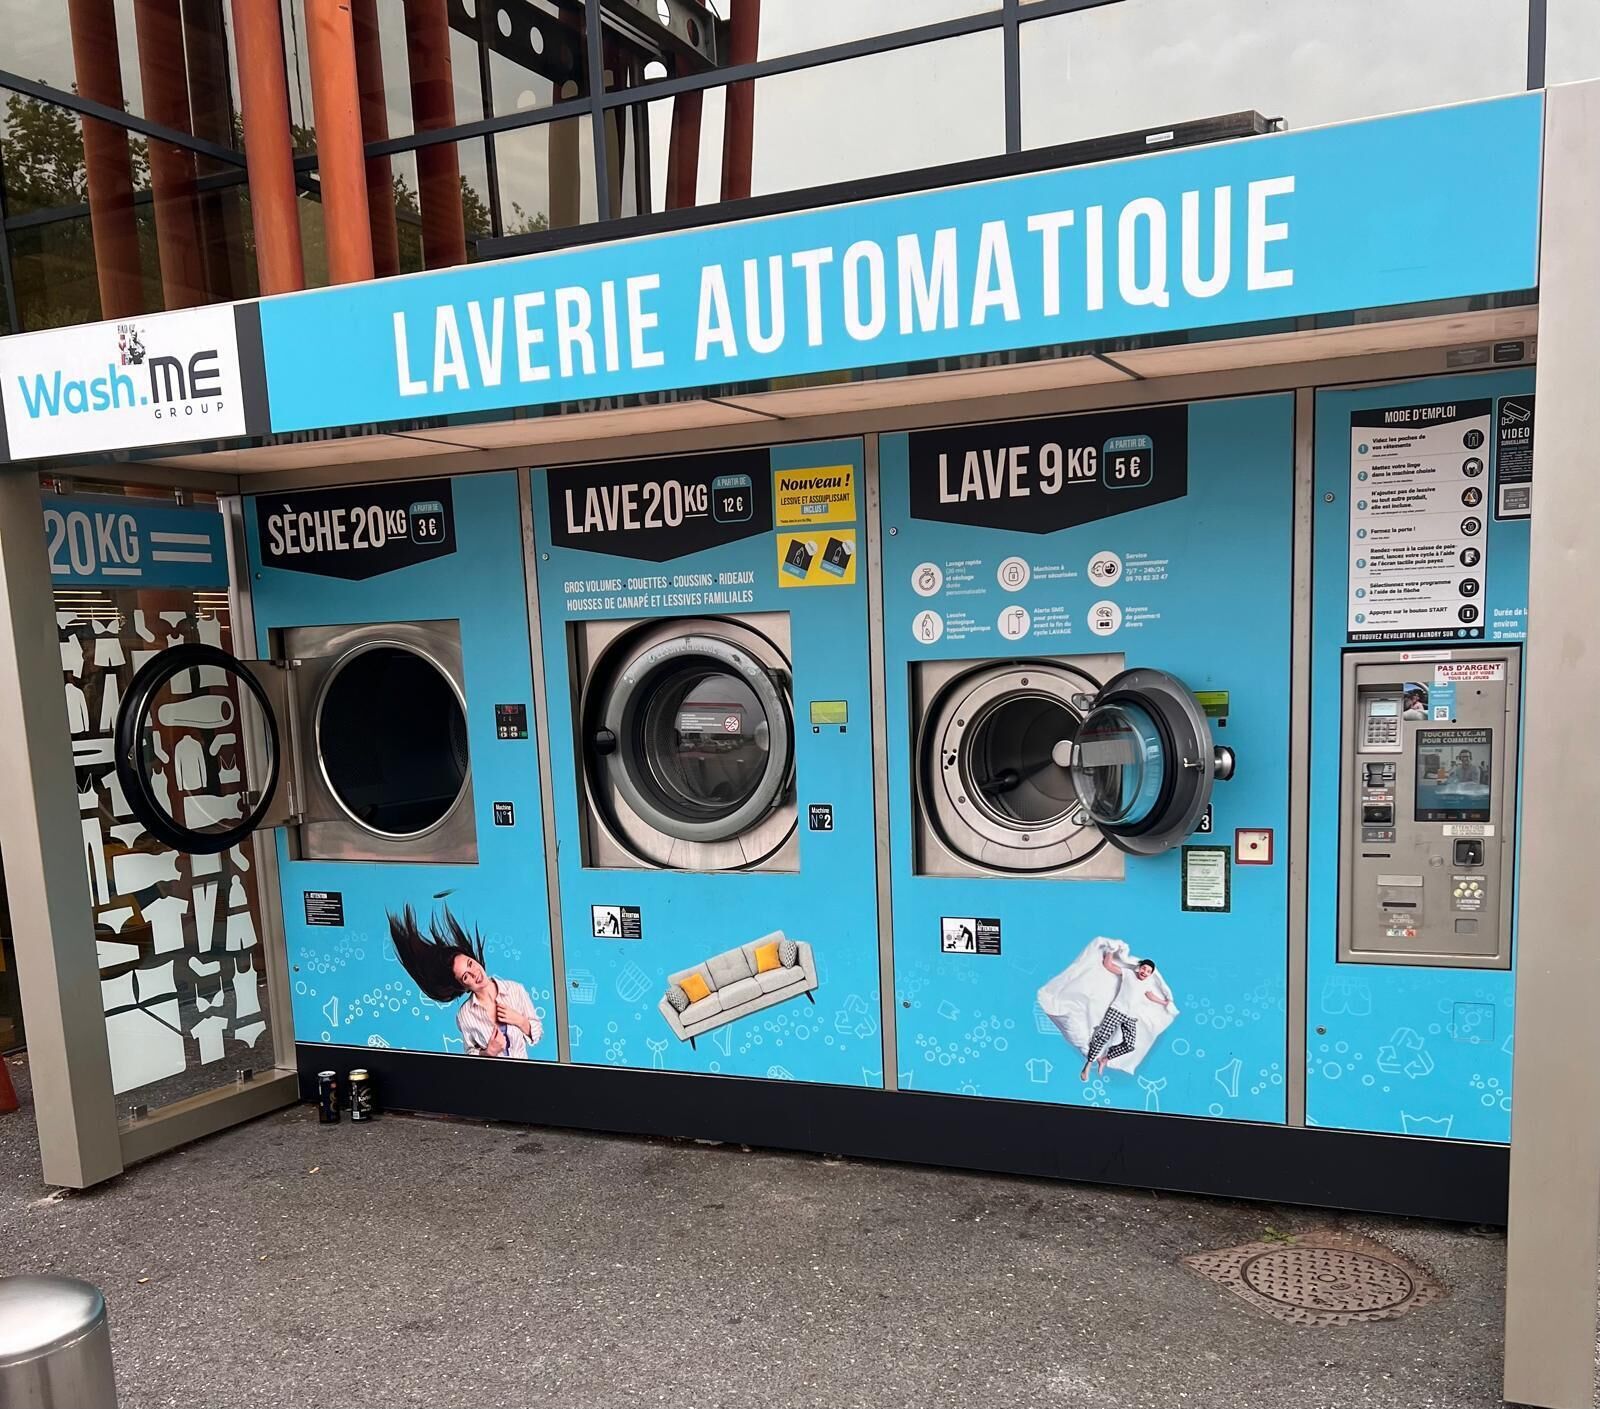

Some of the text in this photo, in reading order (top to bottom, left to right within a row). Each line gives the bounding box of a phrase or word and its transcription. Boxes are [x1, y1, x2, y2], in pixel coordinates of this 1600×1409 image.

[392, 175, 1295, 397] LAVERIE AUTOMATIQUE
[154, 402, 224, 419] GROUP
[1384, 405, 1456, 423] MODE D'EMPLOI
[1501, 427, 1530, 439] VIDEO
[1115, 437, 1146, 449] PARTIR DE
[721, 477, 746, 487] PARTIR DE
[938, 445, 1030, 504] LAVE
[780, 477, 841, 491] Nouveau
[722, 498, 734, 513] 12
[780, 493, 850, 506] LESSIVE ET ASSOUPLISSANT
[565, 483, 641, 534] LAVE
[803, 505, 822, 513] INCLUS
[268, 504, 349, 556] SÈCHE
[564, 571, 754, 593] GROS VOLUMES COUETTES COUSSINS RIDEAUX
[567, 590, 753, 611] HOUSSES DE CANAPÉ ET LESSIVES FAMILIALES
[1493, 608, 1522, 616] Durée de
[811, 807, 829, 815] Machine
